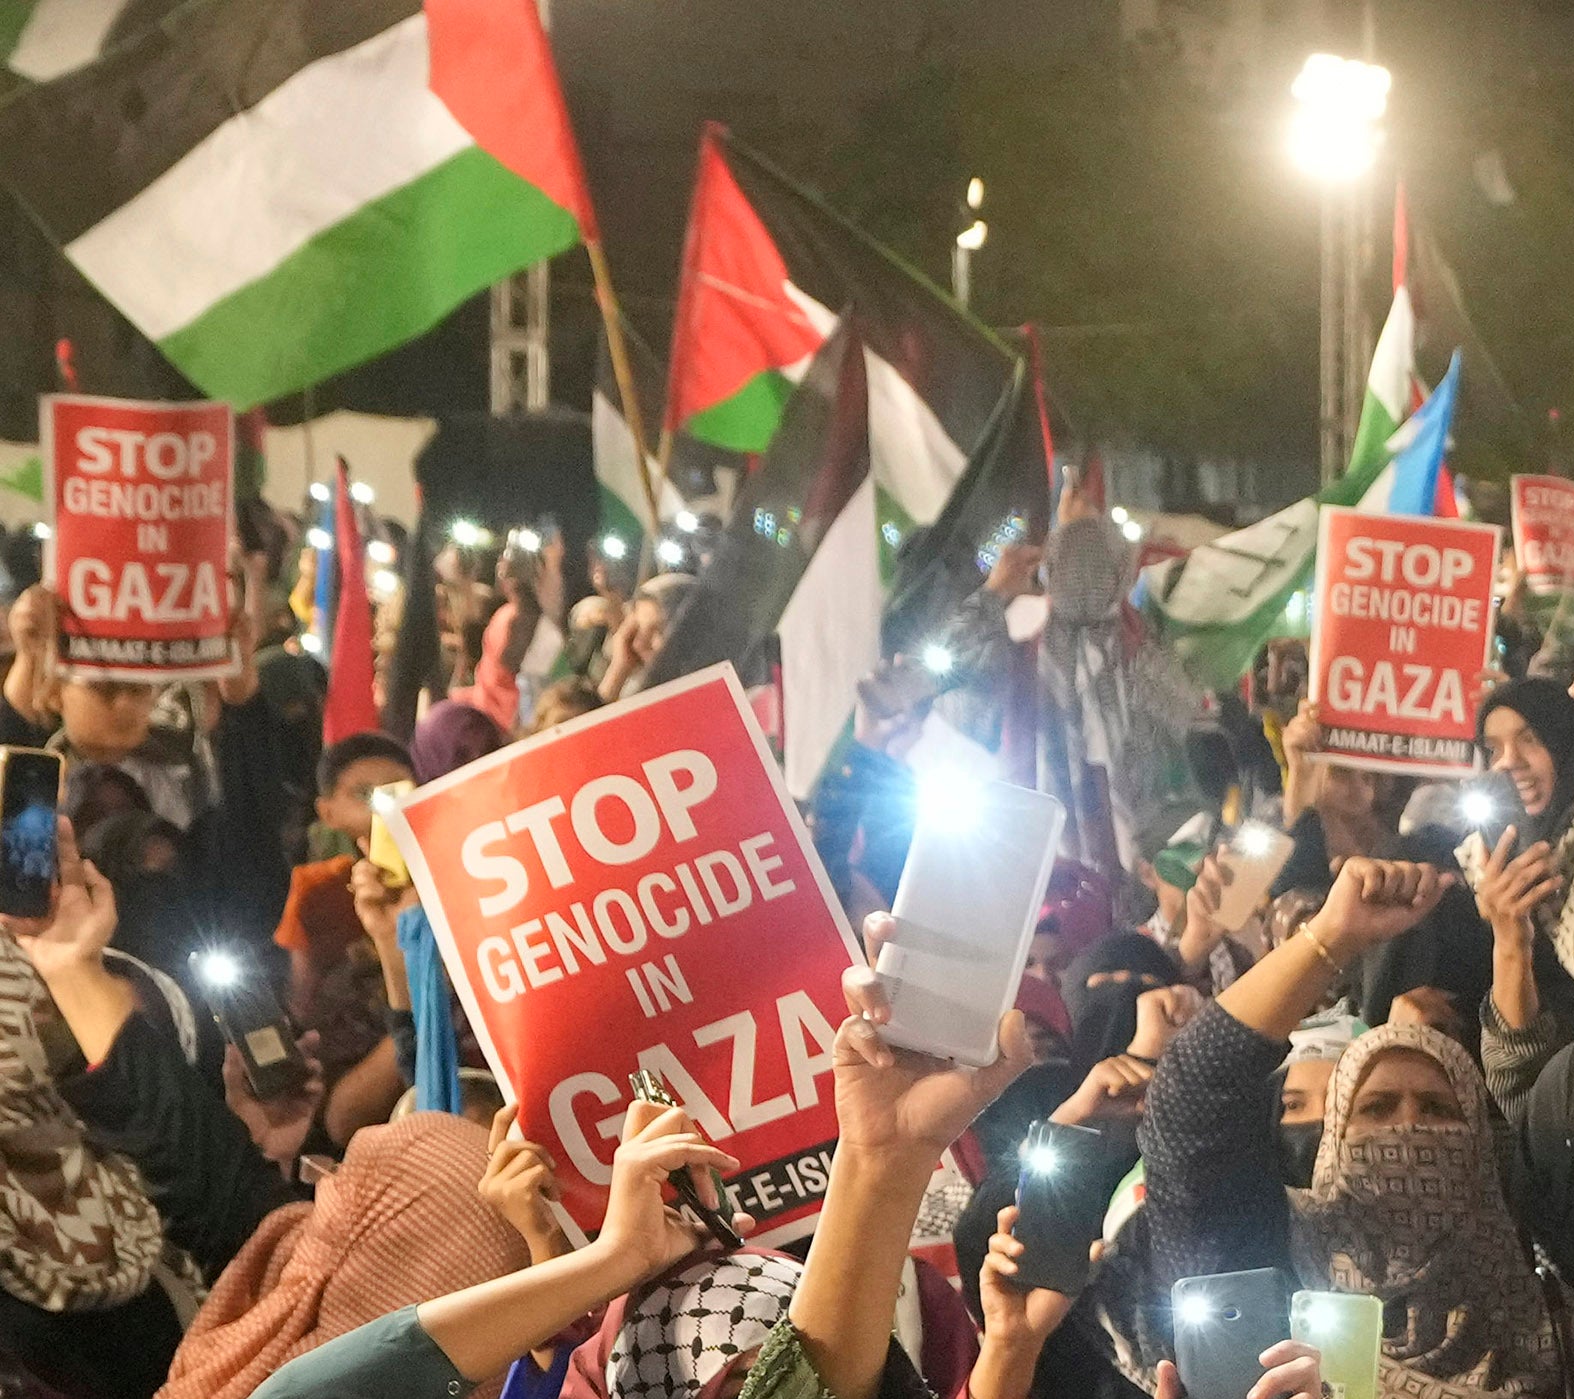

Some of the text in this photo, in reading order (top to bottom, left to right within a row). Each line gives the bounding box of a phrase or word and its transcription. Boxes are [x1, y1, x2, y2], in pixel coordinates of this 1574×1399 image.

[76, 426, 216, 479] STOP
[63, 476, 224, 521] GENOCIDE
[137, 523, 169, 554] IN
[1344, 536, 1474, 589] STOP
[69, 557, 220, 622] GAZA
[1330, 582, 1481, 632] GENOCIDE
[1389, 625, 1417, 654] IN
[1327, 656, 1466, 723] GAZA
[1329, 730, 1467, 760] AMAAT-E-ISLAMI
[460, 749, 719, 918] STOP
[476, 831, 797, 1001] GENOCIDE
[625, 953, 694, 1018] IN
